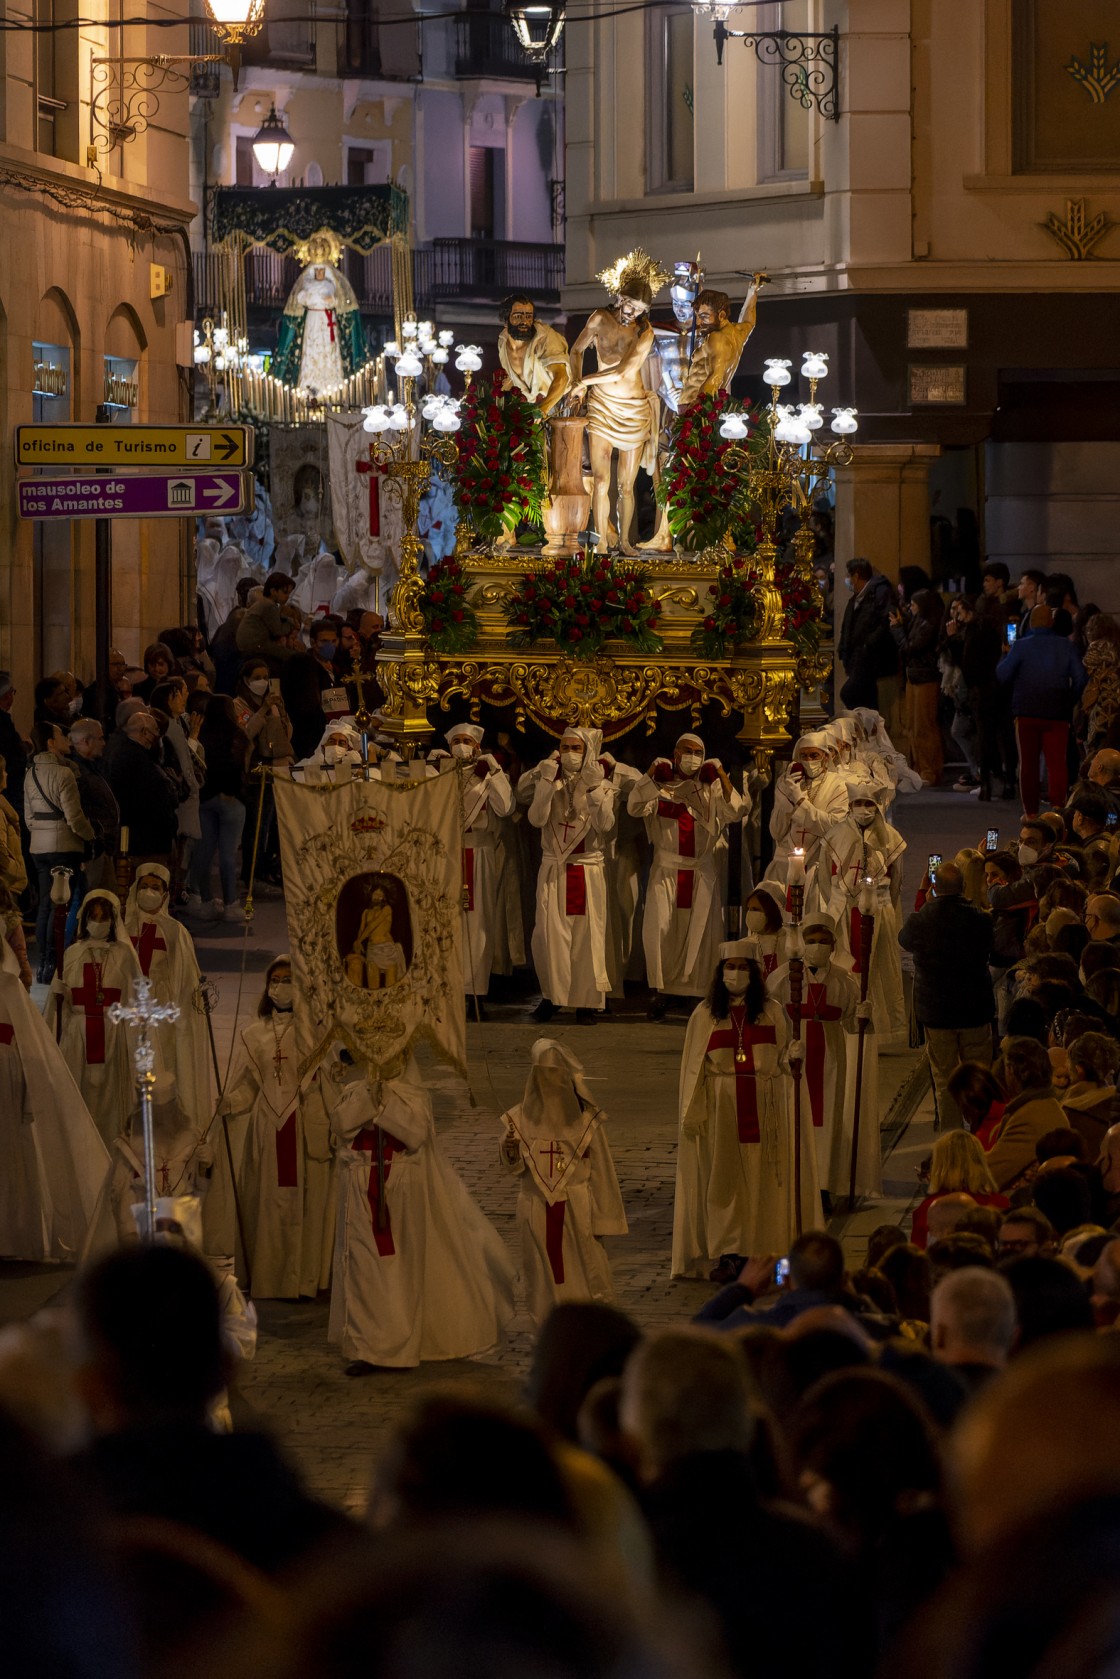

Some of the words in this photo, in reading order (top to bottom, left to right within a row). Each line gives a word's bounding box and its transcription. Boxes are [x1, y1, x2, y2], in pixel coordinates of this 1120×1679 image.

[23, 440, 75, 452] oficina
[85, 440, 104, 452] de
[114, 440, 177, 452] Turismo
[22, 483, 101, 496] mausoleo
[105, 481, 125, 494] de
[23, 499, 46, 511] los
[51, 497, 124, 511] Amantes
